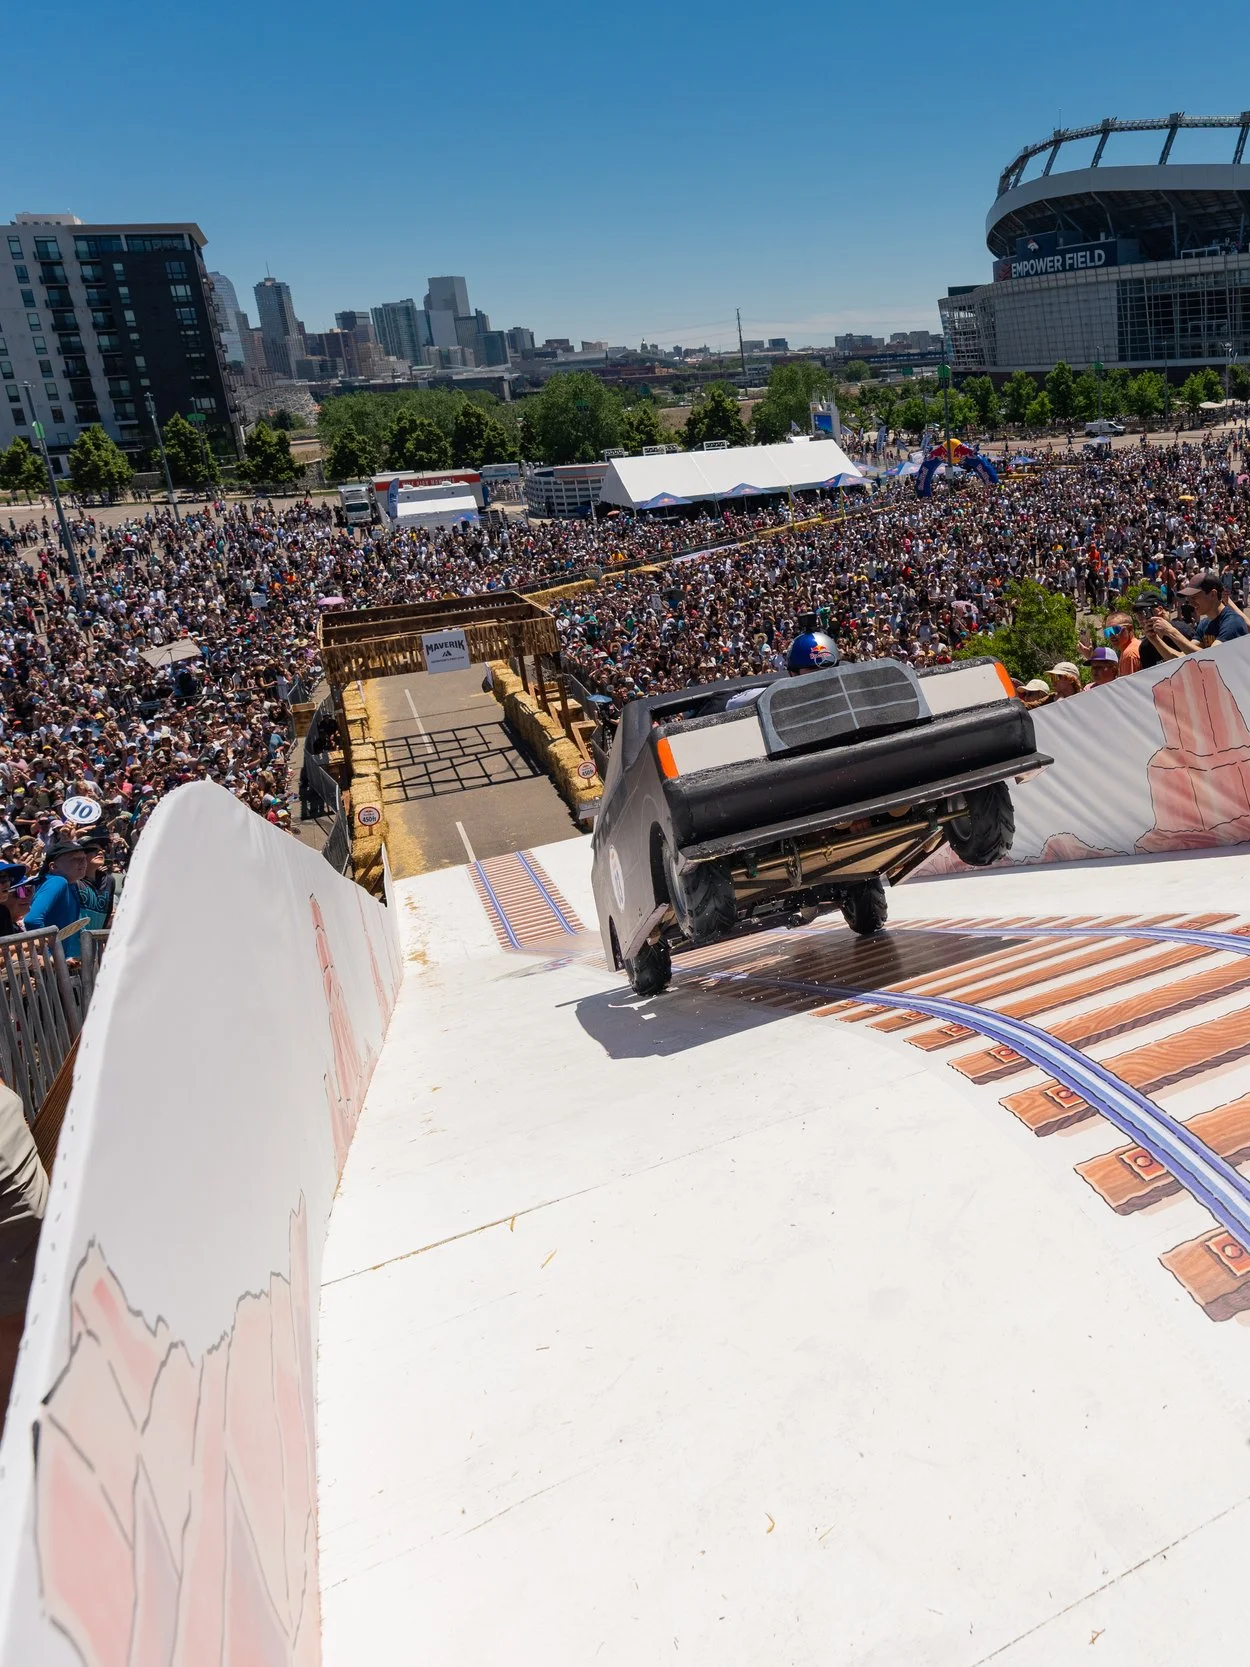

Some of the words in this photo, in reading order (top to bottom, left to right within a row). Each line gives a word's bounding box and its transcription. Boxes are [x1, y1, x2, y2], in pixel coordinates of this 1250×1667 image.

[1011, 255, 1062, 278] EMPOWER
[1065, 249, 1106, 270] FIELD
[425, 640, 466, 657] MAVERIK
[71, 801, 94, 819] 10
